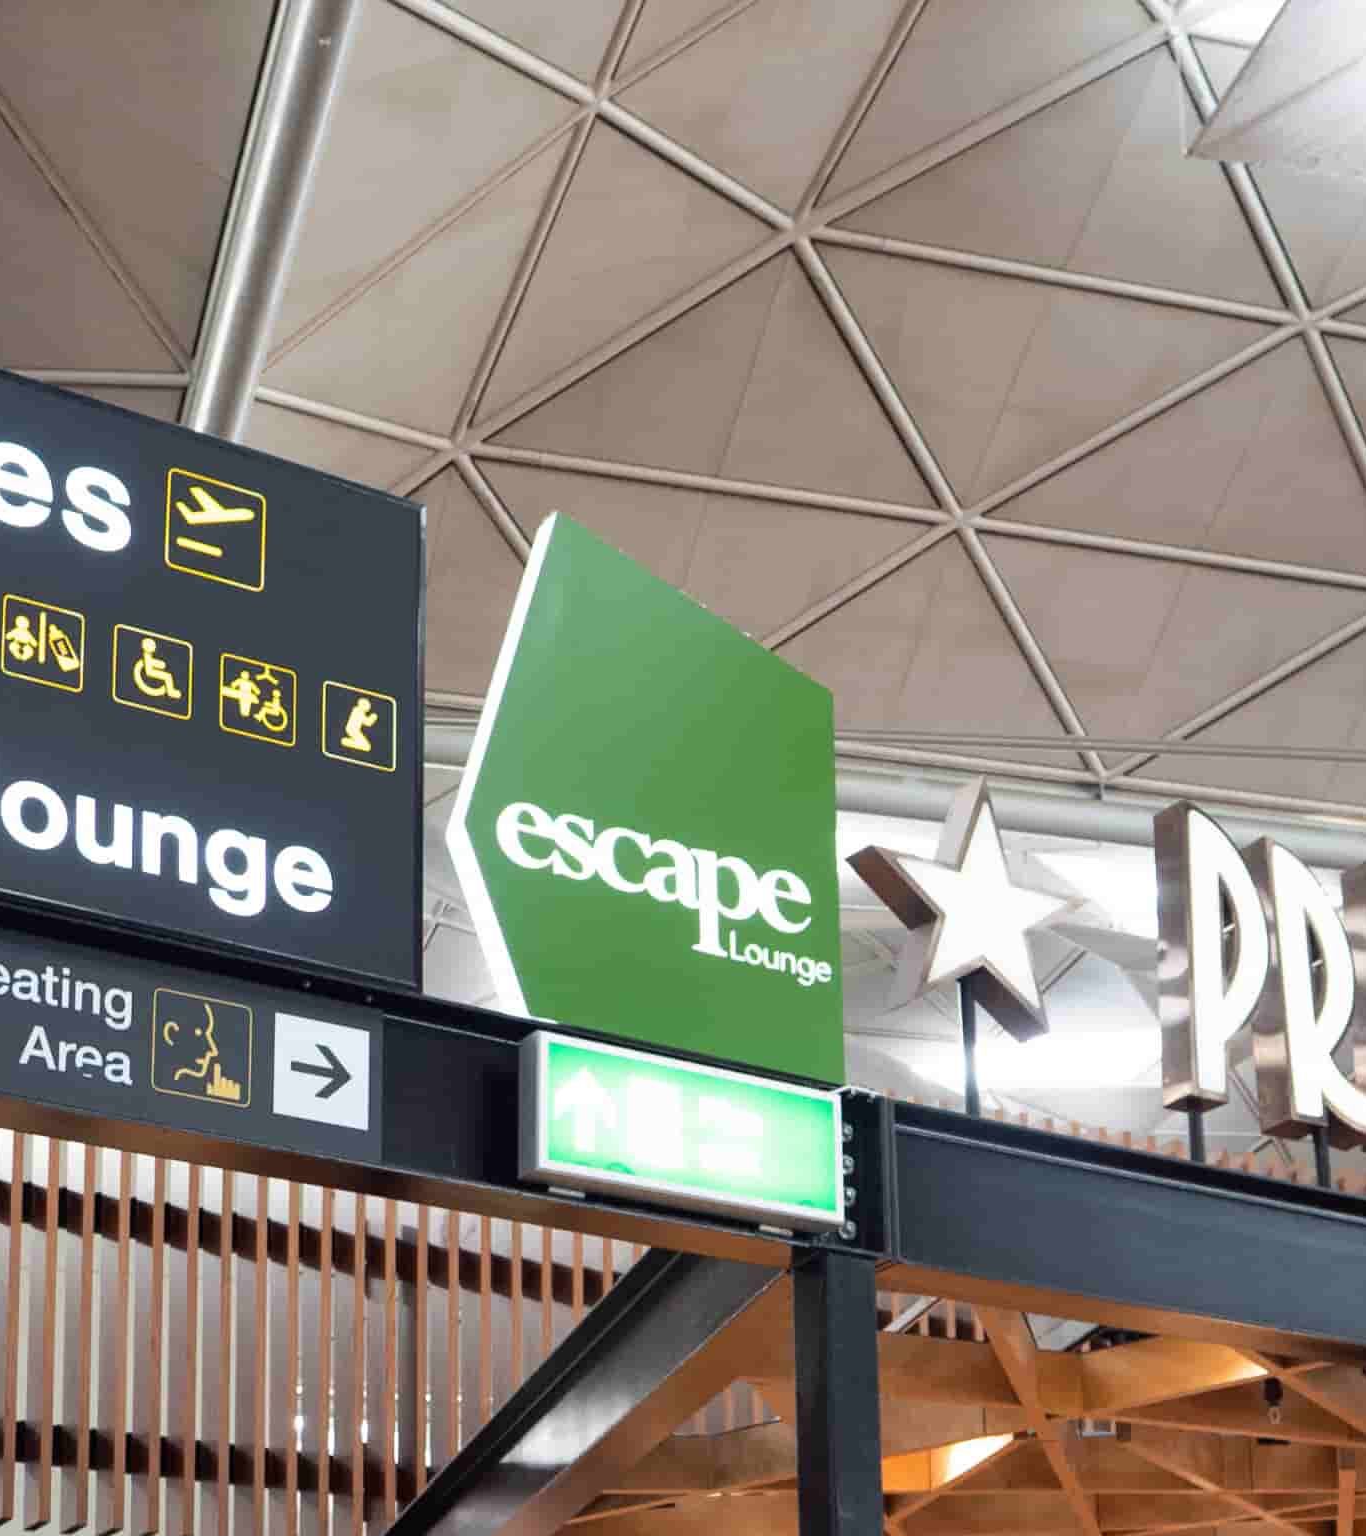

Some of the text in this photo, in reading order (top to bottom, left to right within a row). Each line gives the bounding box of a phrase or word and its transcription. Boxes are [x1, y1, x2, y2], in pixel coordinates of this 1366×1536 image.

[495, 800, 813, 960] escape
[728, 931, 833, 986] Lounge
[18, 1025, 134, 1086] Area
